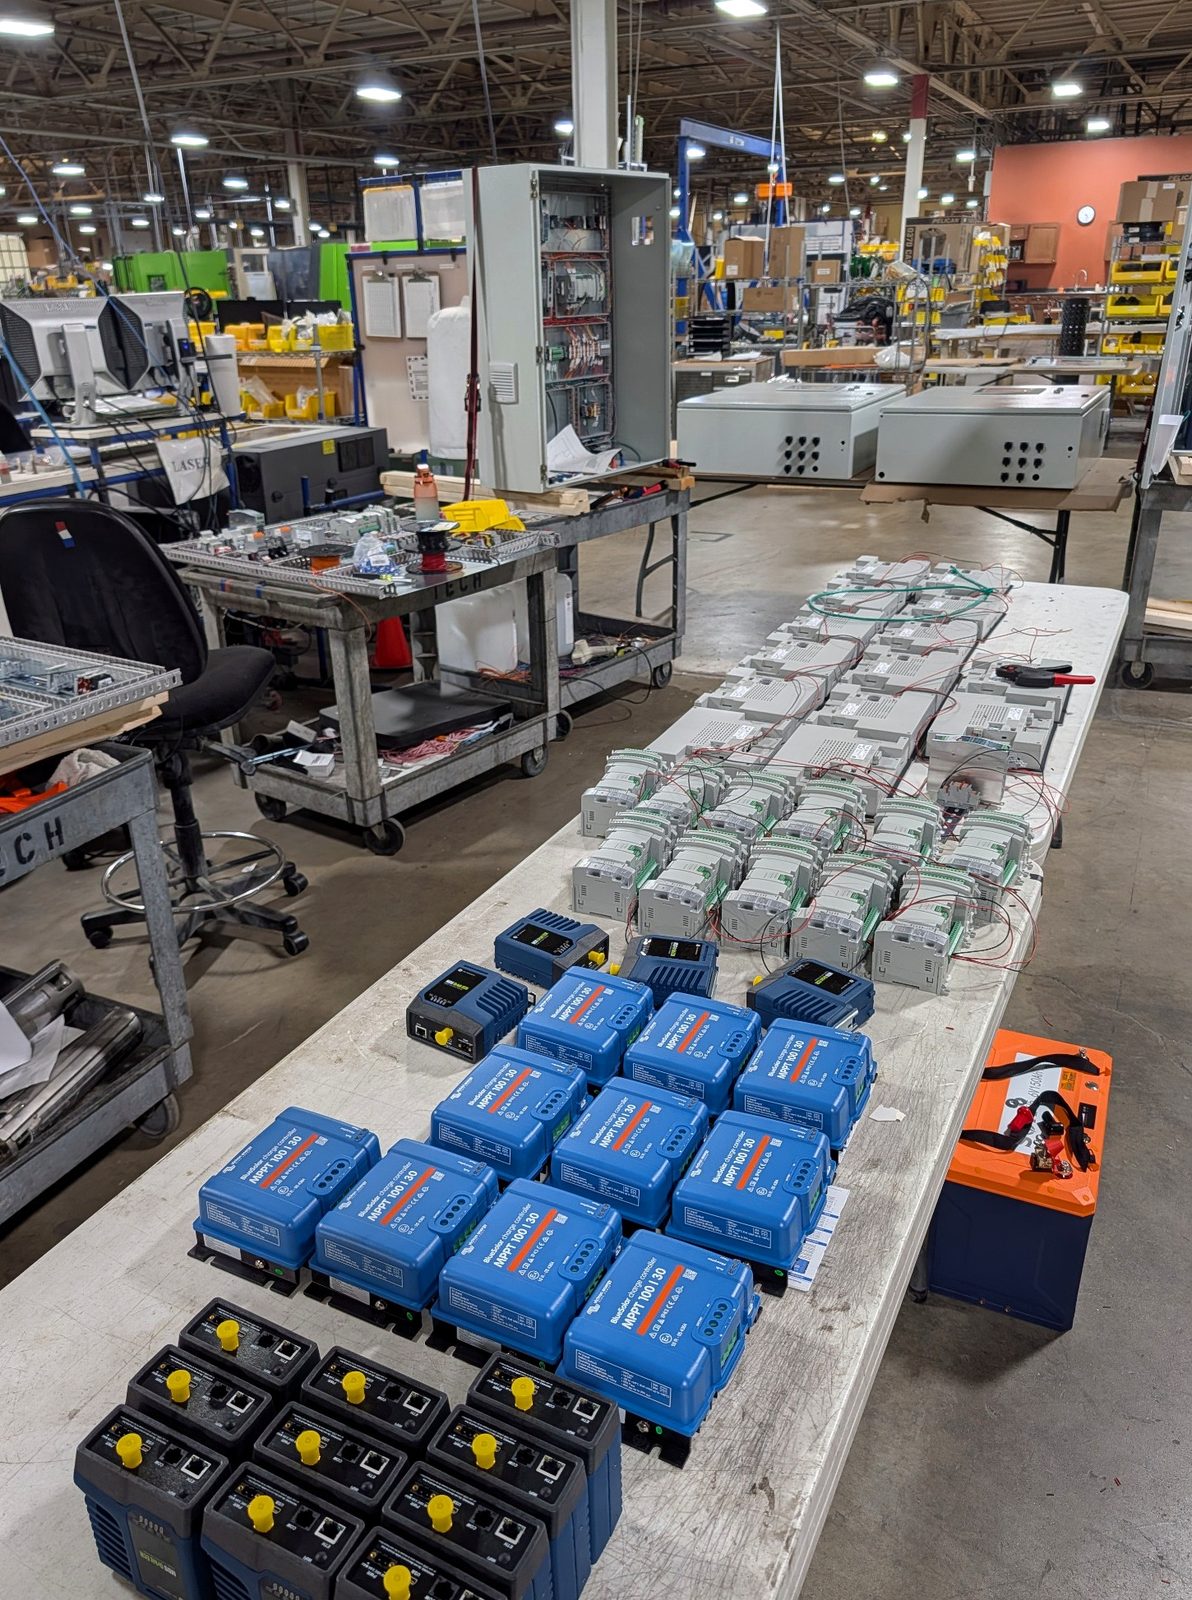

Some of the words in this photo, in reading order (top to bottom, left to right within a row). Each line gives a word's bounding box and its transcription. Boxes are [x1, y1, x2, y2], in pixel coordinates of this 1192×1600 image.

[432, 572, 481, 600] TECH
[249, 1162, 274, 1184] MPPT
[270, 1150, 288, 1162] 100
[288, 1136, 302, 1146] 30
[722, 1165, 740, 1186] MPPT
[734, 1152, 748, 1164] 100
[744, 1138, 756, 1148] 30
[368, 1198, 391, 1222] MPPT
[387, 1185, 404, 1198] 100
[404, 1170, 418, 1181] 30
[494, 1242, 516, 1268] MPPT
[511, 1228, 528, 1242] 100
[526, 1212, 540, 1224] 30
[622, 1302, 644, 1329] MPPT
[638, 1286, 655, 1301] 100
[652, 1268, 666, 1280] 30
[629, 1279, 642, 1298] charge
